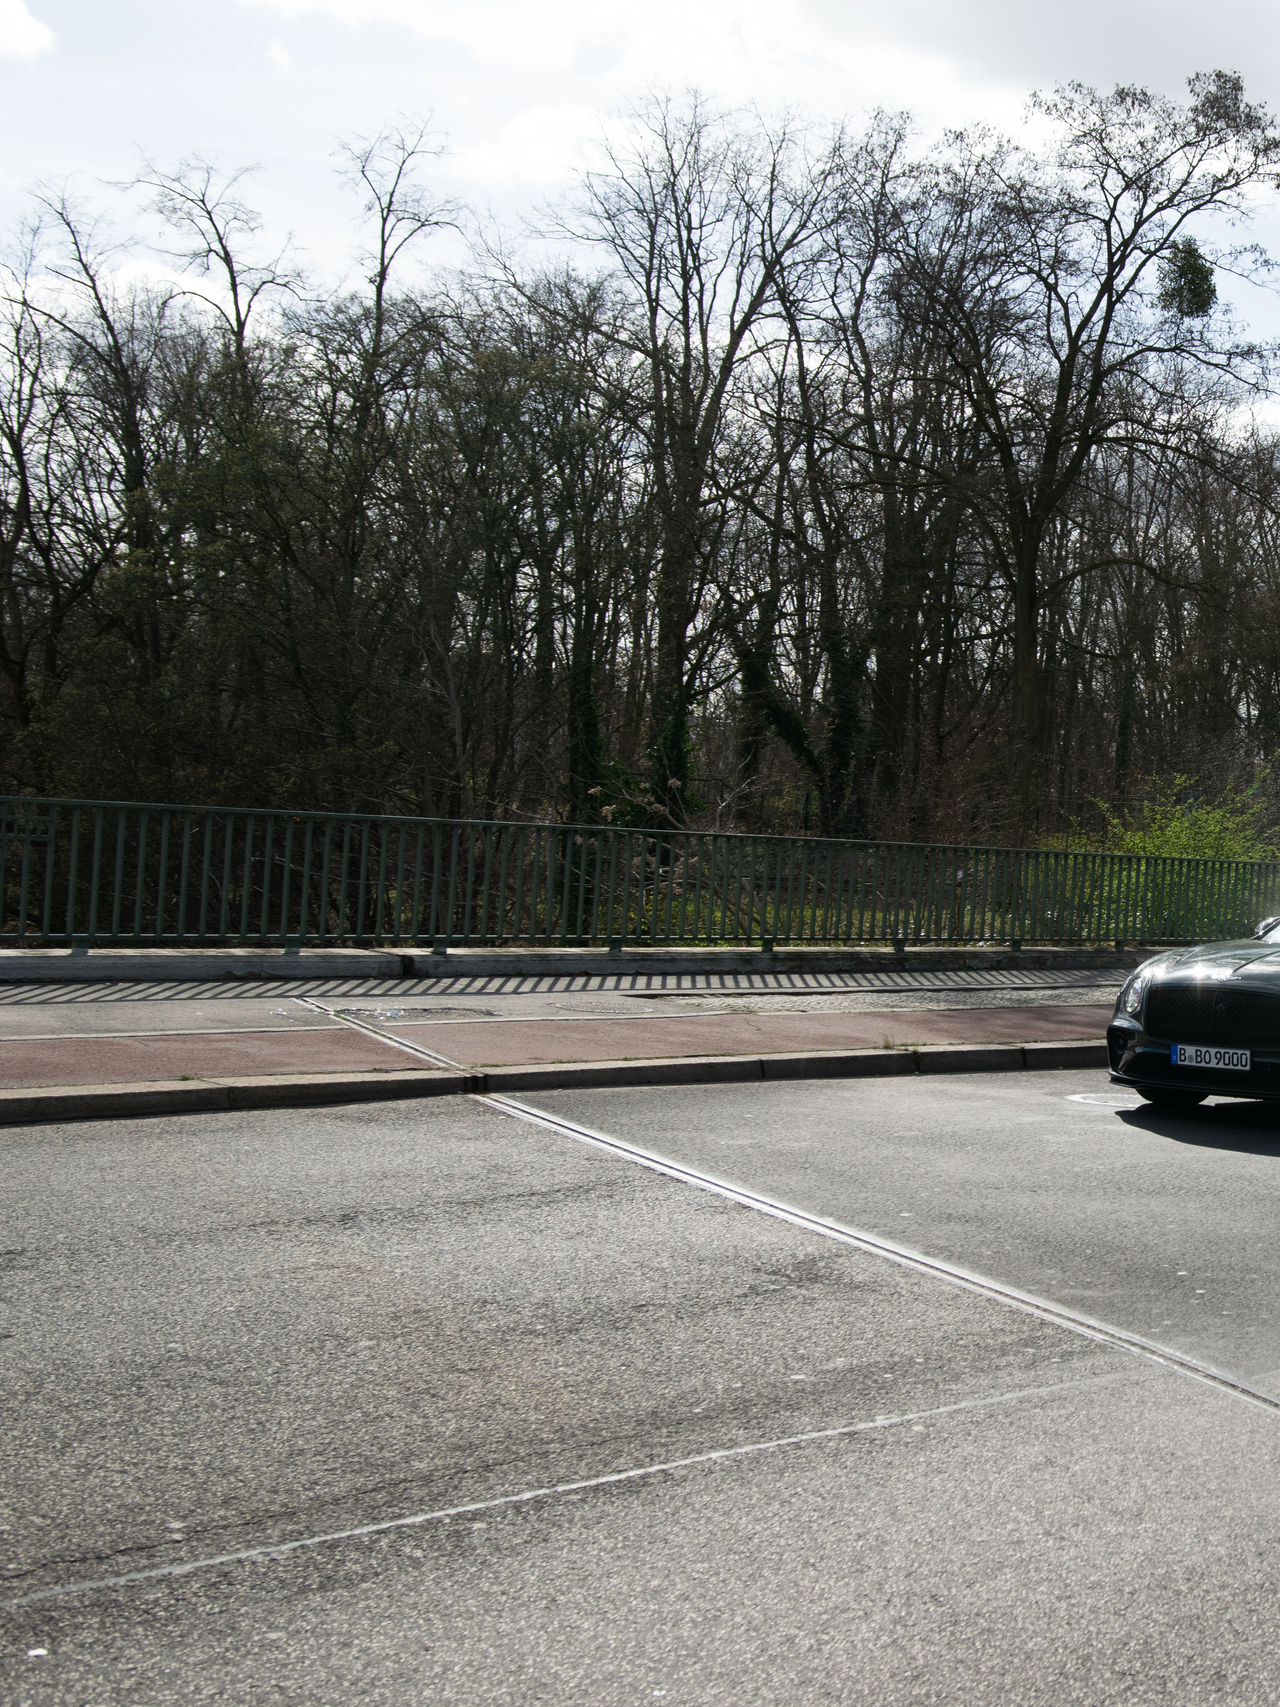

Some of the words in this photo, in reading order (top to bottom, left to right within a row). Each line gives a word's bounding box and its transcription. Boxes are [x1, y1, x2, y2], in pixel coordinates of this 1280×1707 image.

[1178, 1047, 1187, 1063] B
[1195, 1049, 1212, 1065] BO
[1214, 1050, 1248, 1068] 9000
